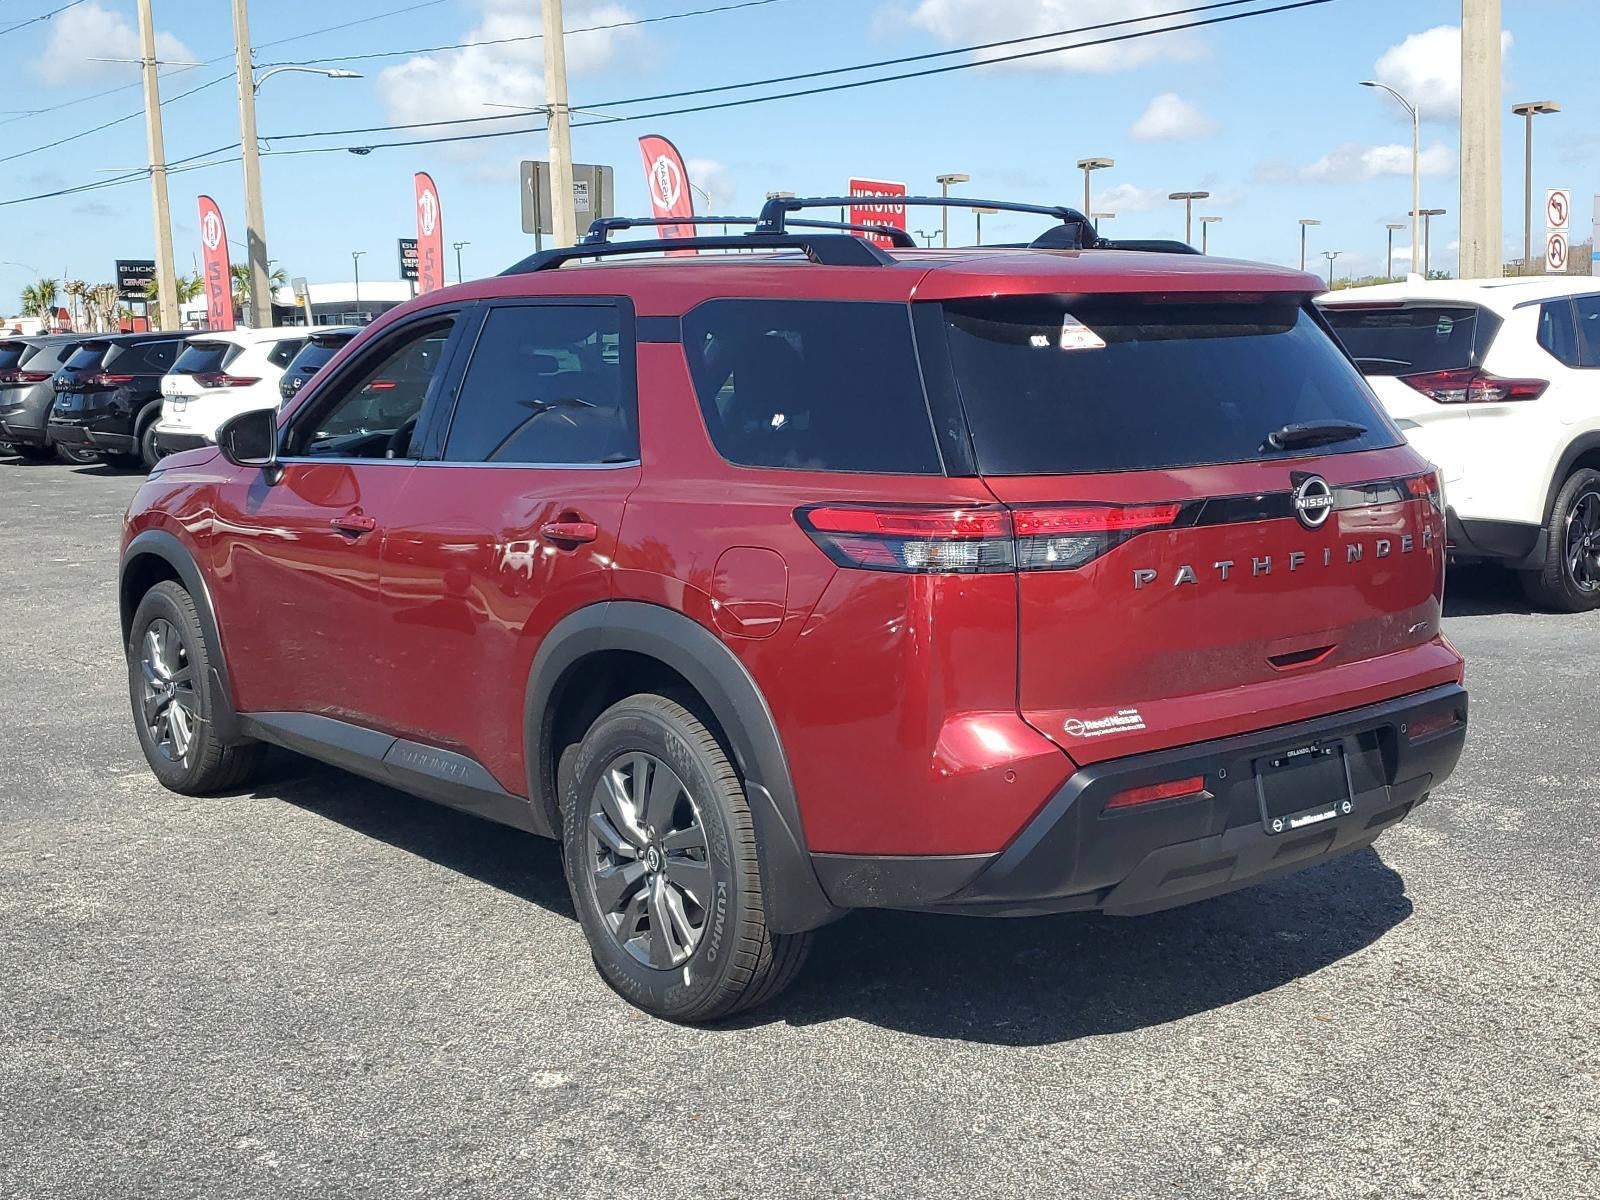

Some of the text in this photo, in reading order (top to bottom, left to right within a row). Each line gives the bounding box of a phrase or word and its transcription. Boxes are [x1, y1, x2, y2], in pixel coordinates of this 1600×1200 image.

[853, 189, 903, 214] WRONG
[863, 219, 893, 242] WAY
[1297, 495, 1334, 508] NISSAN
[1133, 530, 1432, 589] PATHFINDER
[1084, 715, 1142, 729] Reed Nissan
[707, 881, 728, 961] KUMHO
